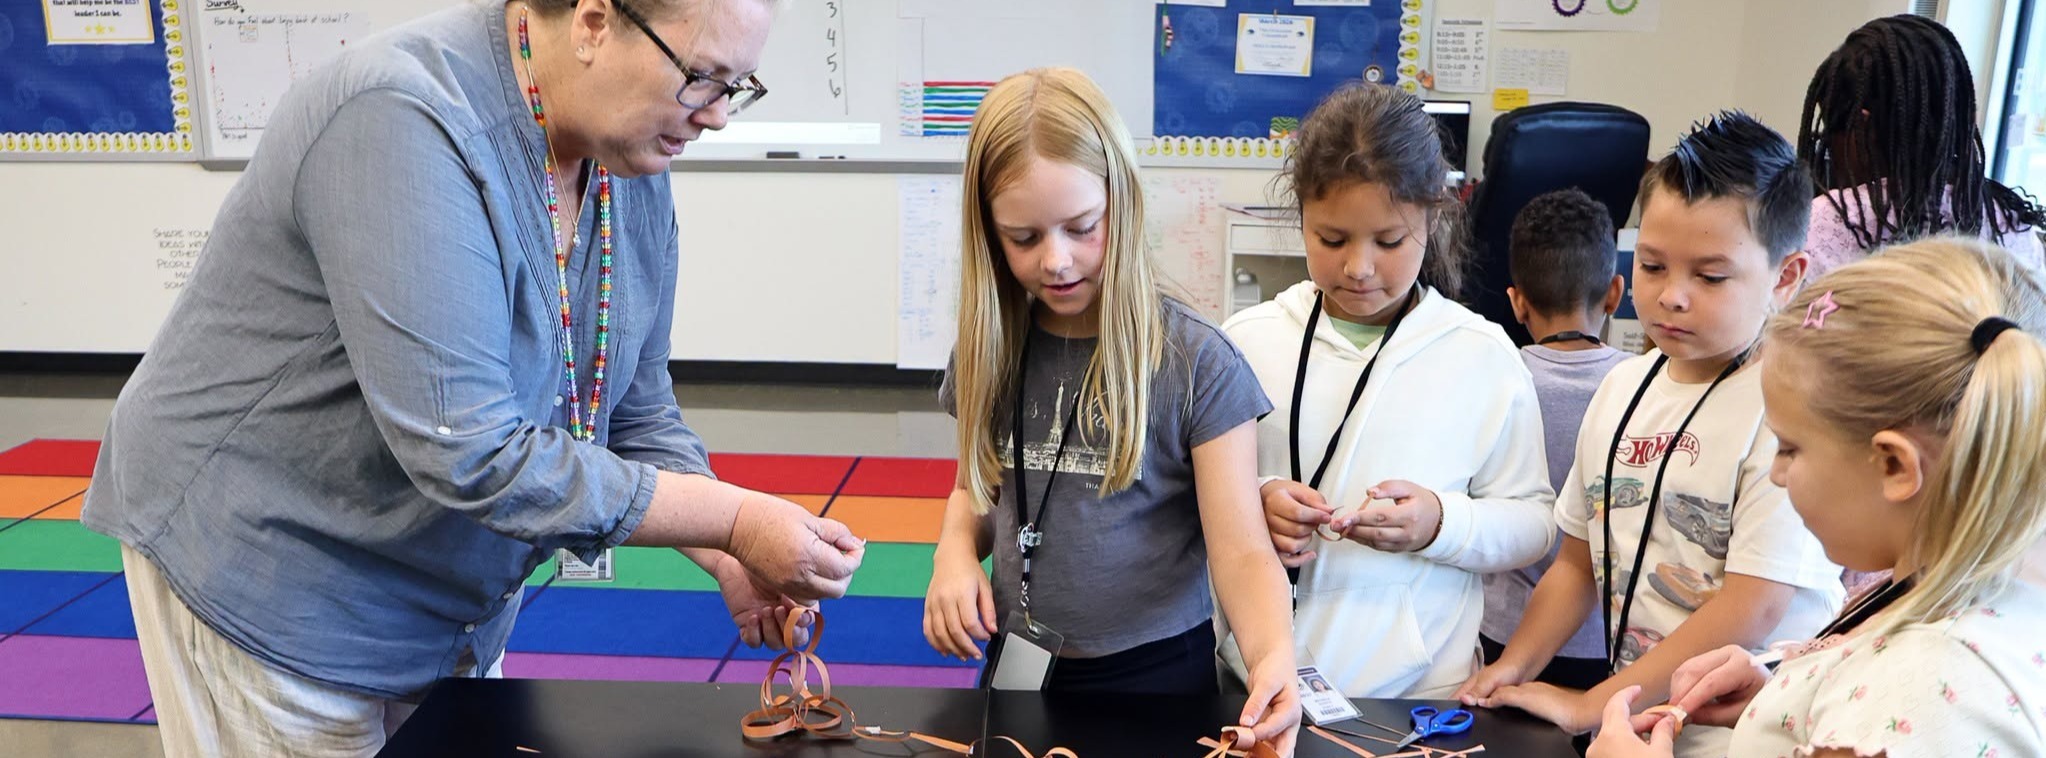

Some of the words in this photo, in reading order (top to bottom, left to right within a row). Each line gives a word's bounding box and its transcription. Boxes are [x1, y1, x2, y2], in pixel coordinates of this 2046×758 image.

[206, 0, 239, 10] Survey
[826, 1, 838, 19] 3
[74, 9, 94, 17] leader
[95, 9, 100, 17] I
[826, 27, 837, 48] 4
[826, 52, 838, 73] 5
[828, 78, 842, 98] 6
[153, 228, 185, 239] SHARE
[188, 229, 209, 238] YOU
[159, 240, 186, 249] IDEAS
[156, 258, 193, 270] PEOPLE
[1627, 440, 1654, 465] HO
